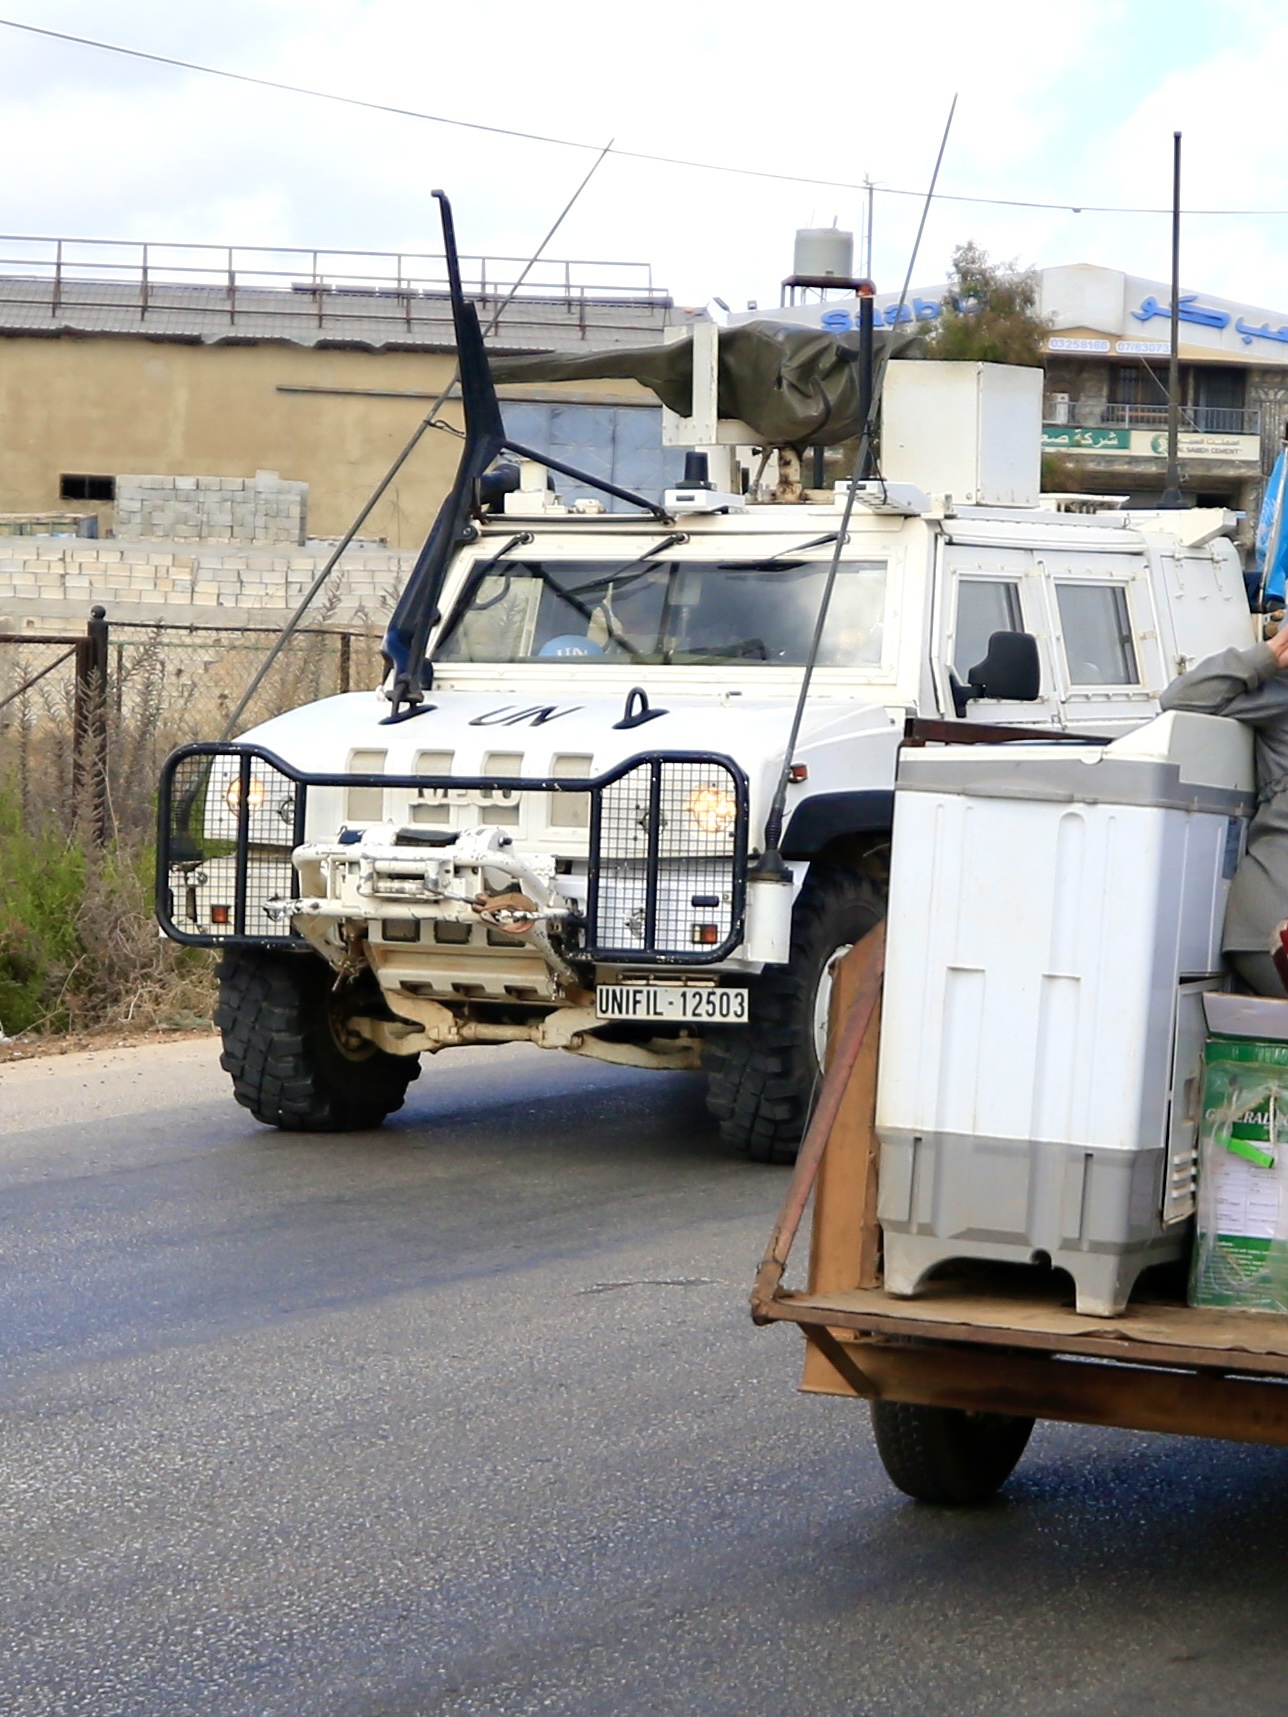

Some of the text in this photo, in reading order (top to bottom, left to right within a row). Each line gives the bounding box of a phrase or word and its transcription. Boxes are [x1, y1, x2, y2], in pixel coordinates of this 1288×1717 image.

[1130, 295, 1231, 329] كو
[1073, 429, 1119, 448] شركة
[468, 705, 587, 727] UN
